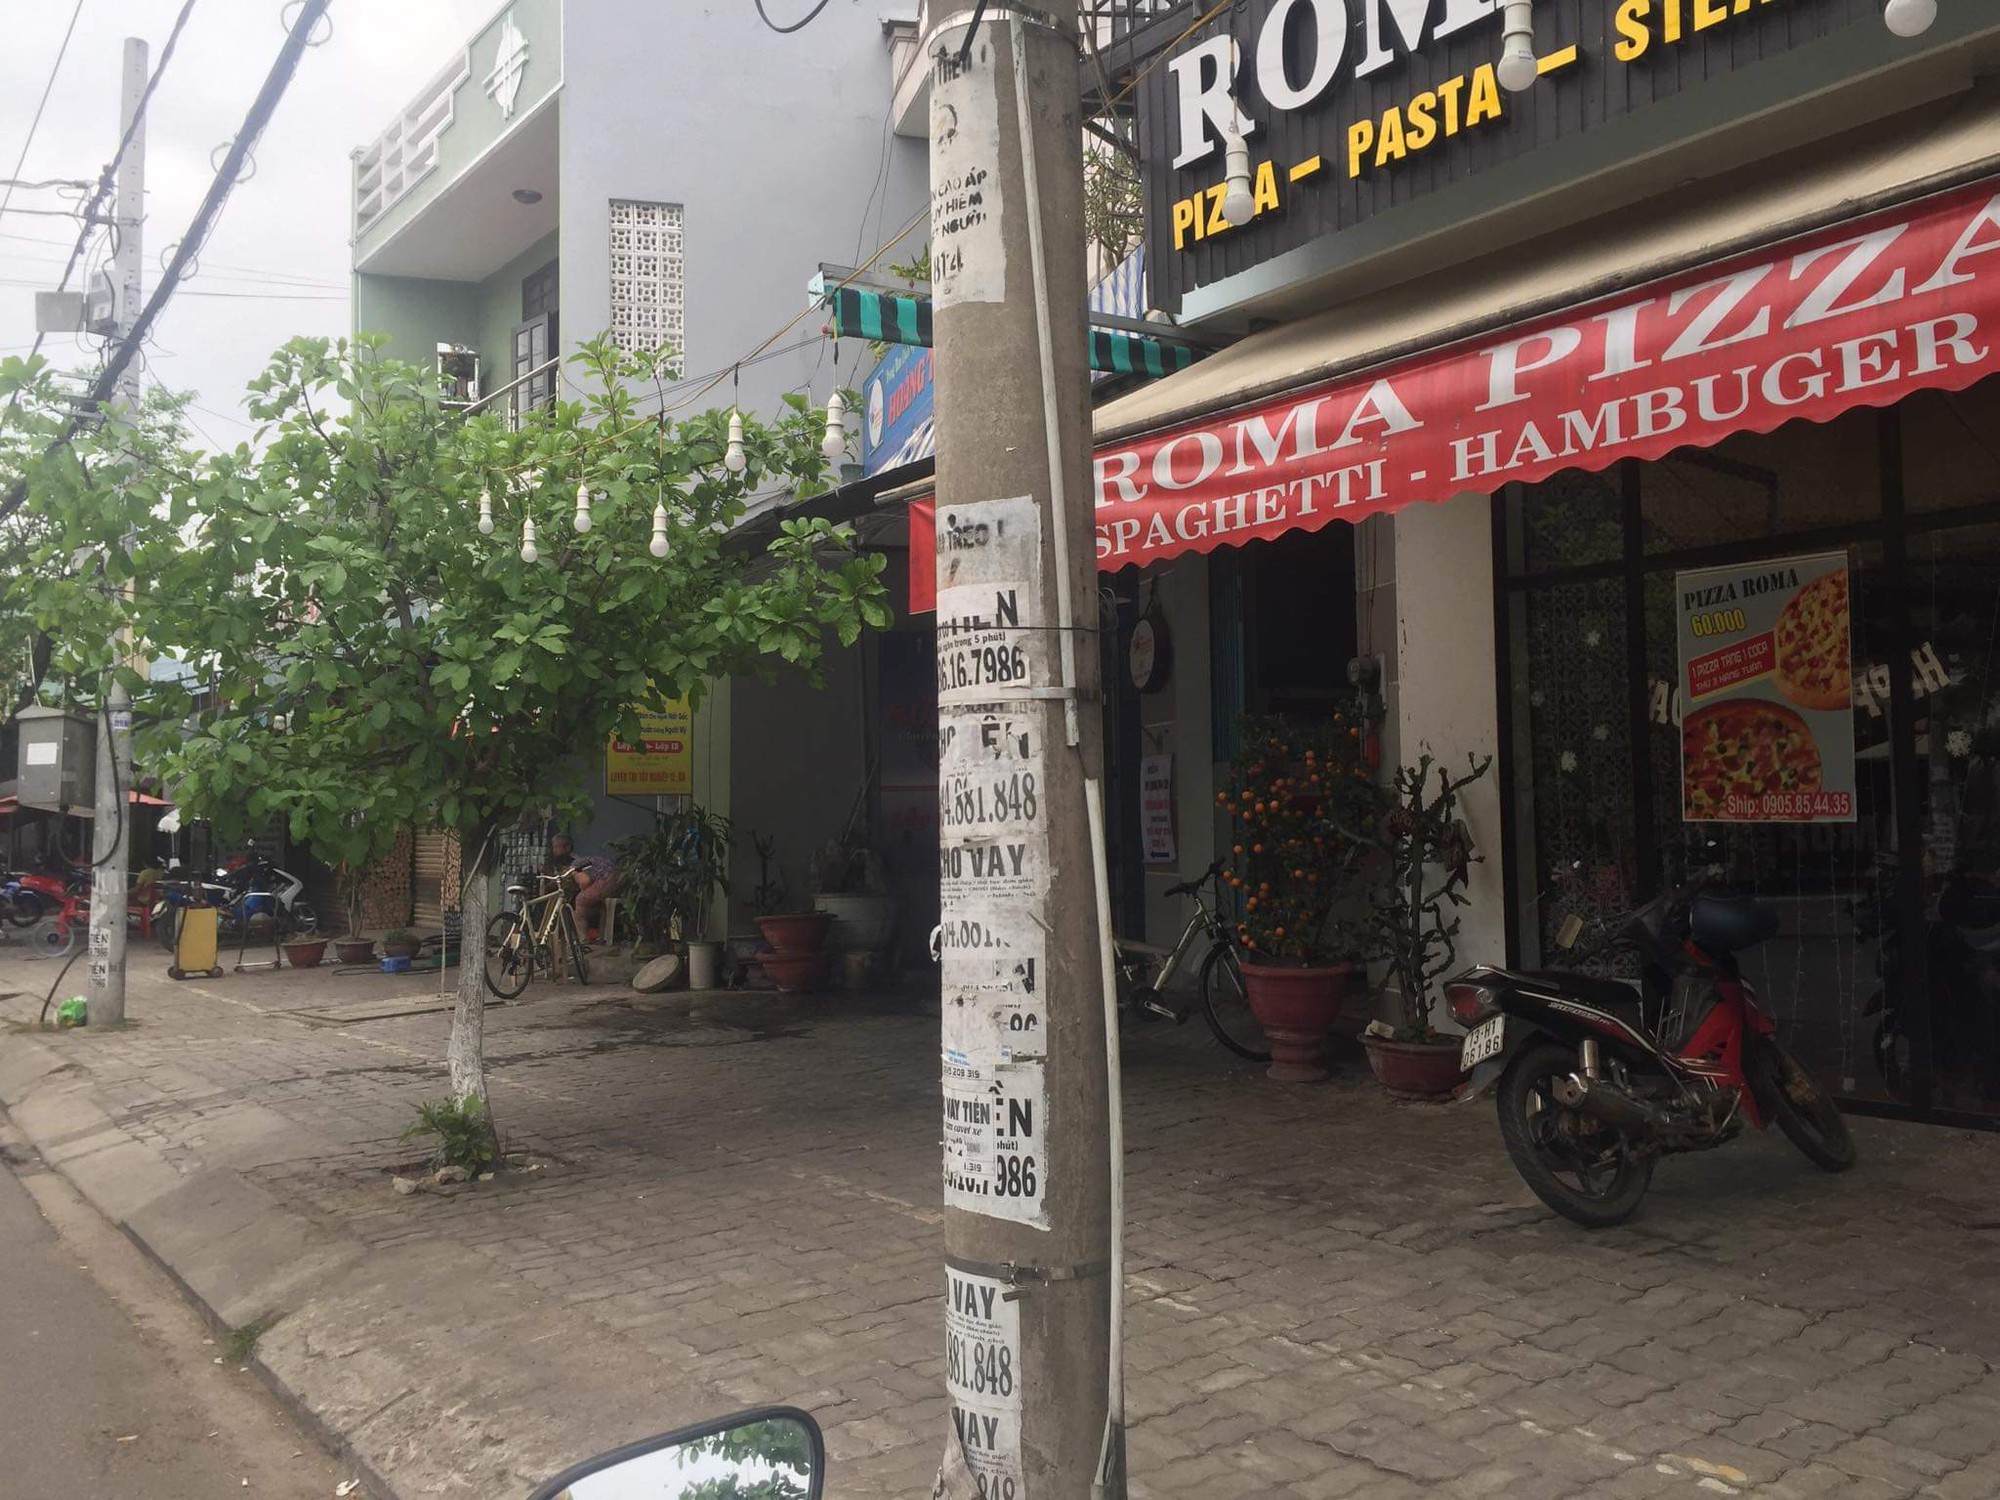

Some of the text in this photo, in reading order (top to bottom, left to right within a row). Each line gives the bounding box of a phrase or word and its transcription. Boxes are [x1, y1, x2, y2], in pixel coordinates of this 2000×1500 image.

[1172, 160, 1279, 251] PIZA
[1348, 62, 1502, 179] PASTA
[1614, 0, 1776, 62] STE
[1093, 378, 1425, 509] ROMA
[1095, 459, 1388, 559] SPAGHETTI
[1449, 312, 1990, 482] HAMBUGER
[1683, 568, 1800, 611] PIZZA ROMA
[1691, 607, 1746, 637] 60.000
[1726, 793, 1849, 817] Ship: 0905.85.44.35
[968, 843, 1027, 878] VAY
[953, 1277, 996, 1320] VAY
[952, 1406, 999, 1451] VAY
